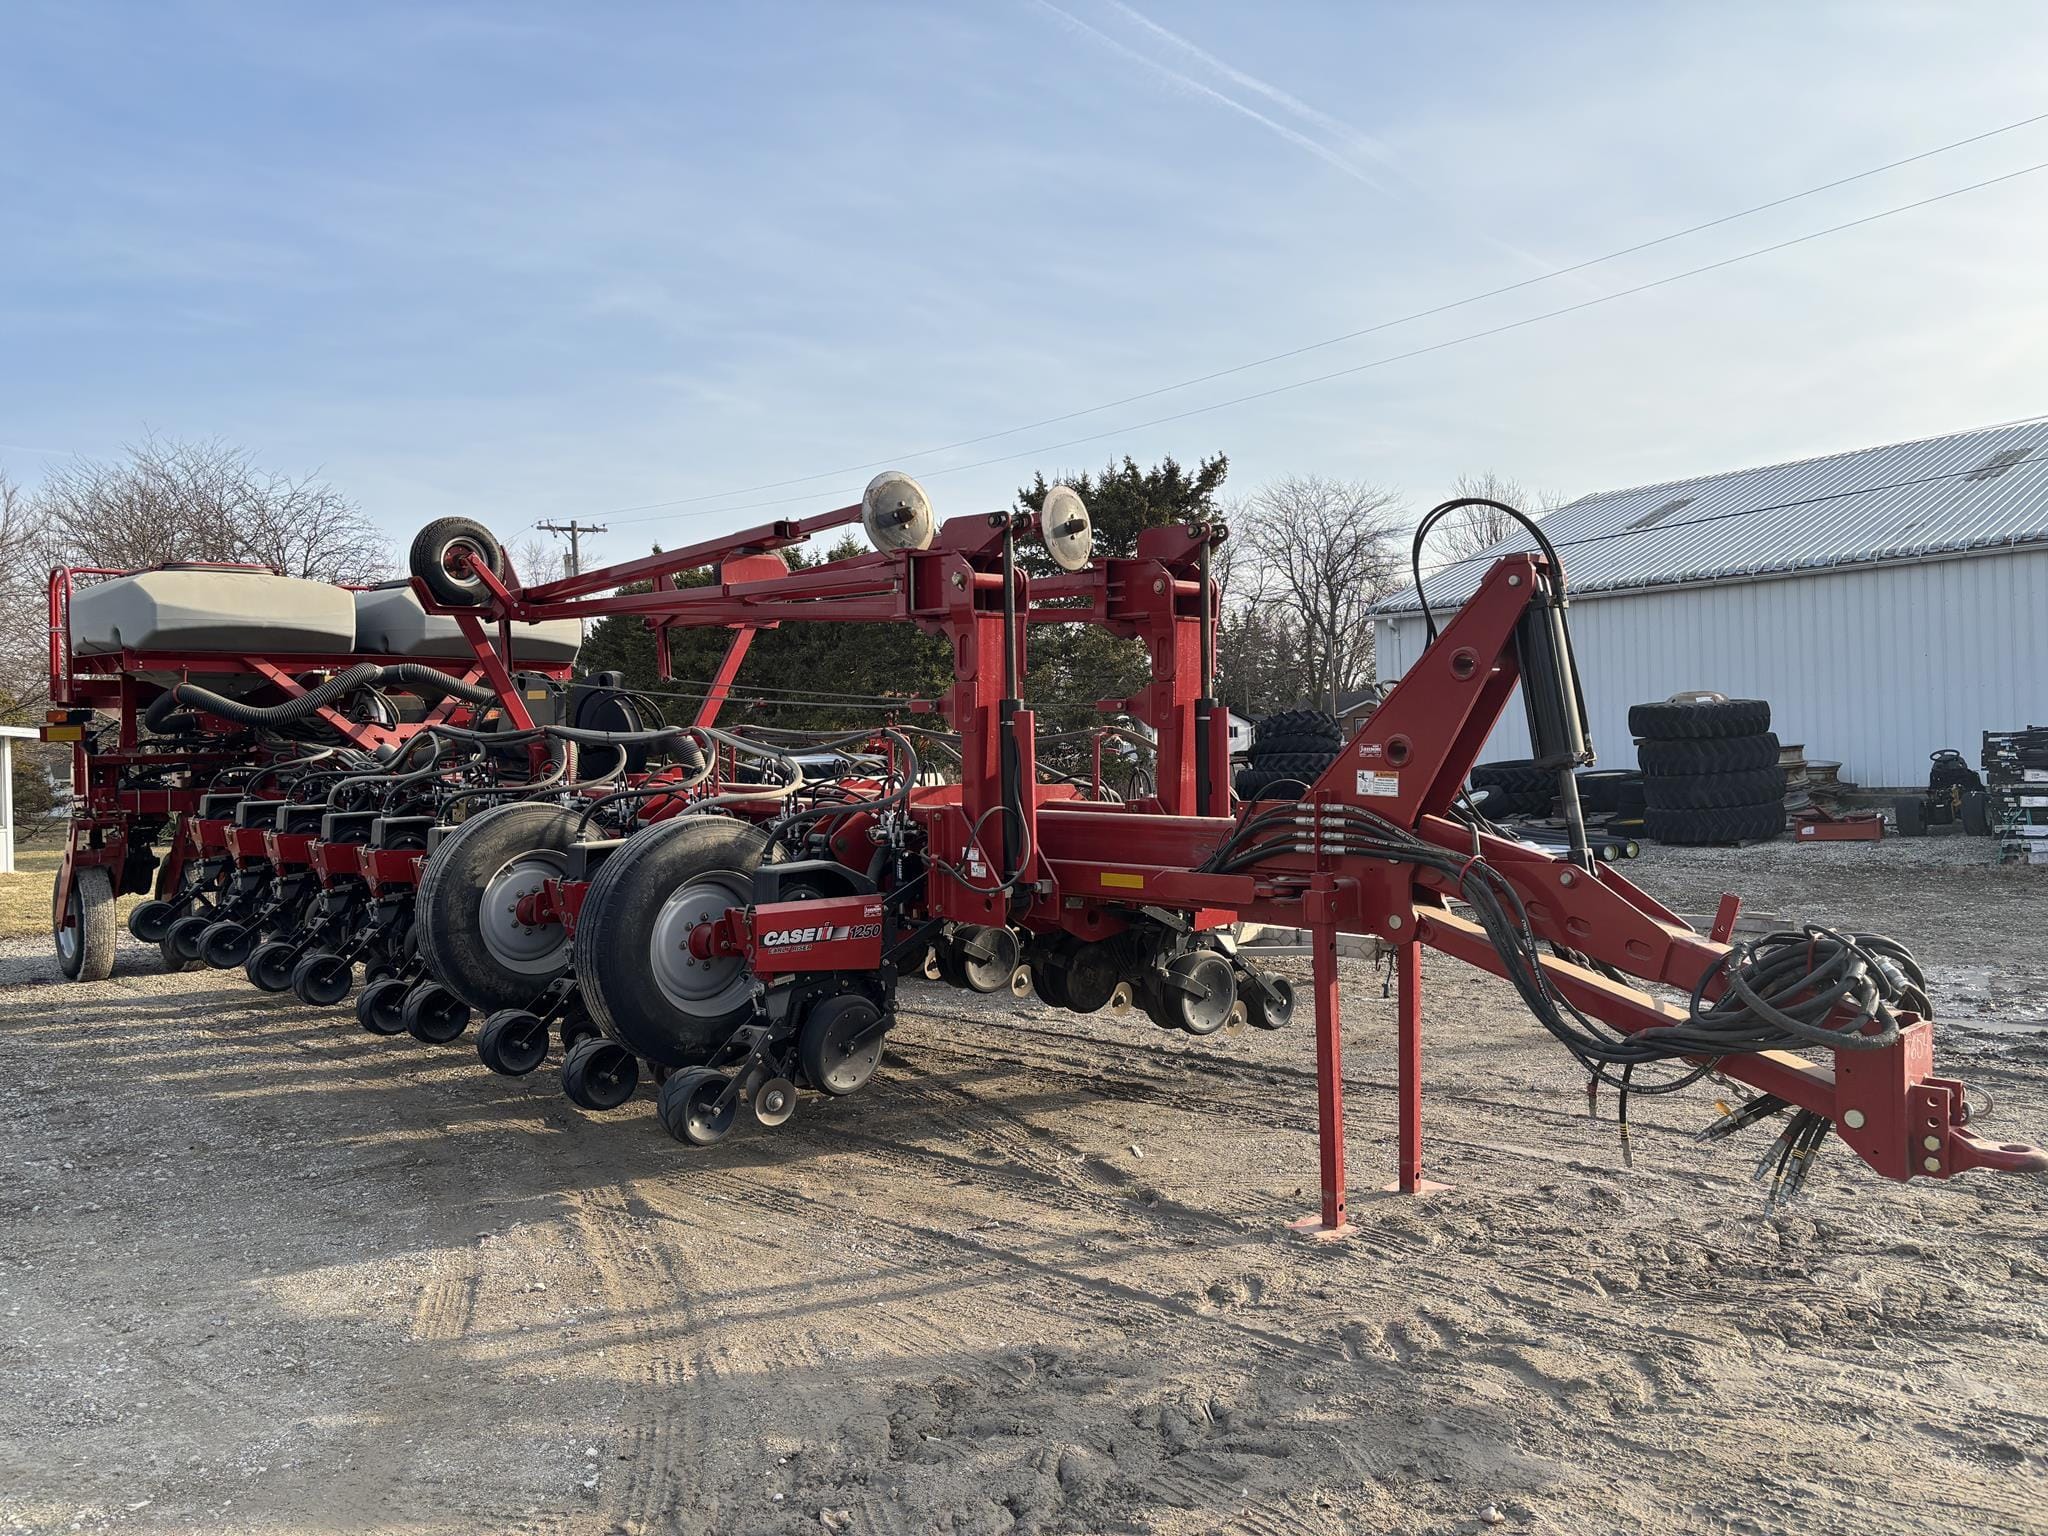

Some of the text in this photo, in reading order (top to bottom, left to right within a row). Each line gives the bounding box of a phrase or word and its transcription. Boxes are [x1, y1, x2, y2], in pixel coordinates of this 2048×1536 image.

[560, 910, 575, 929] 22
[763, 928, 816, 946] CASE
[850, 923, 881, 939] 1250
